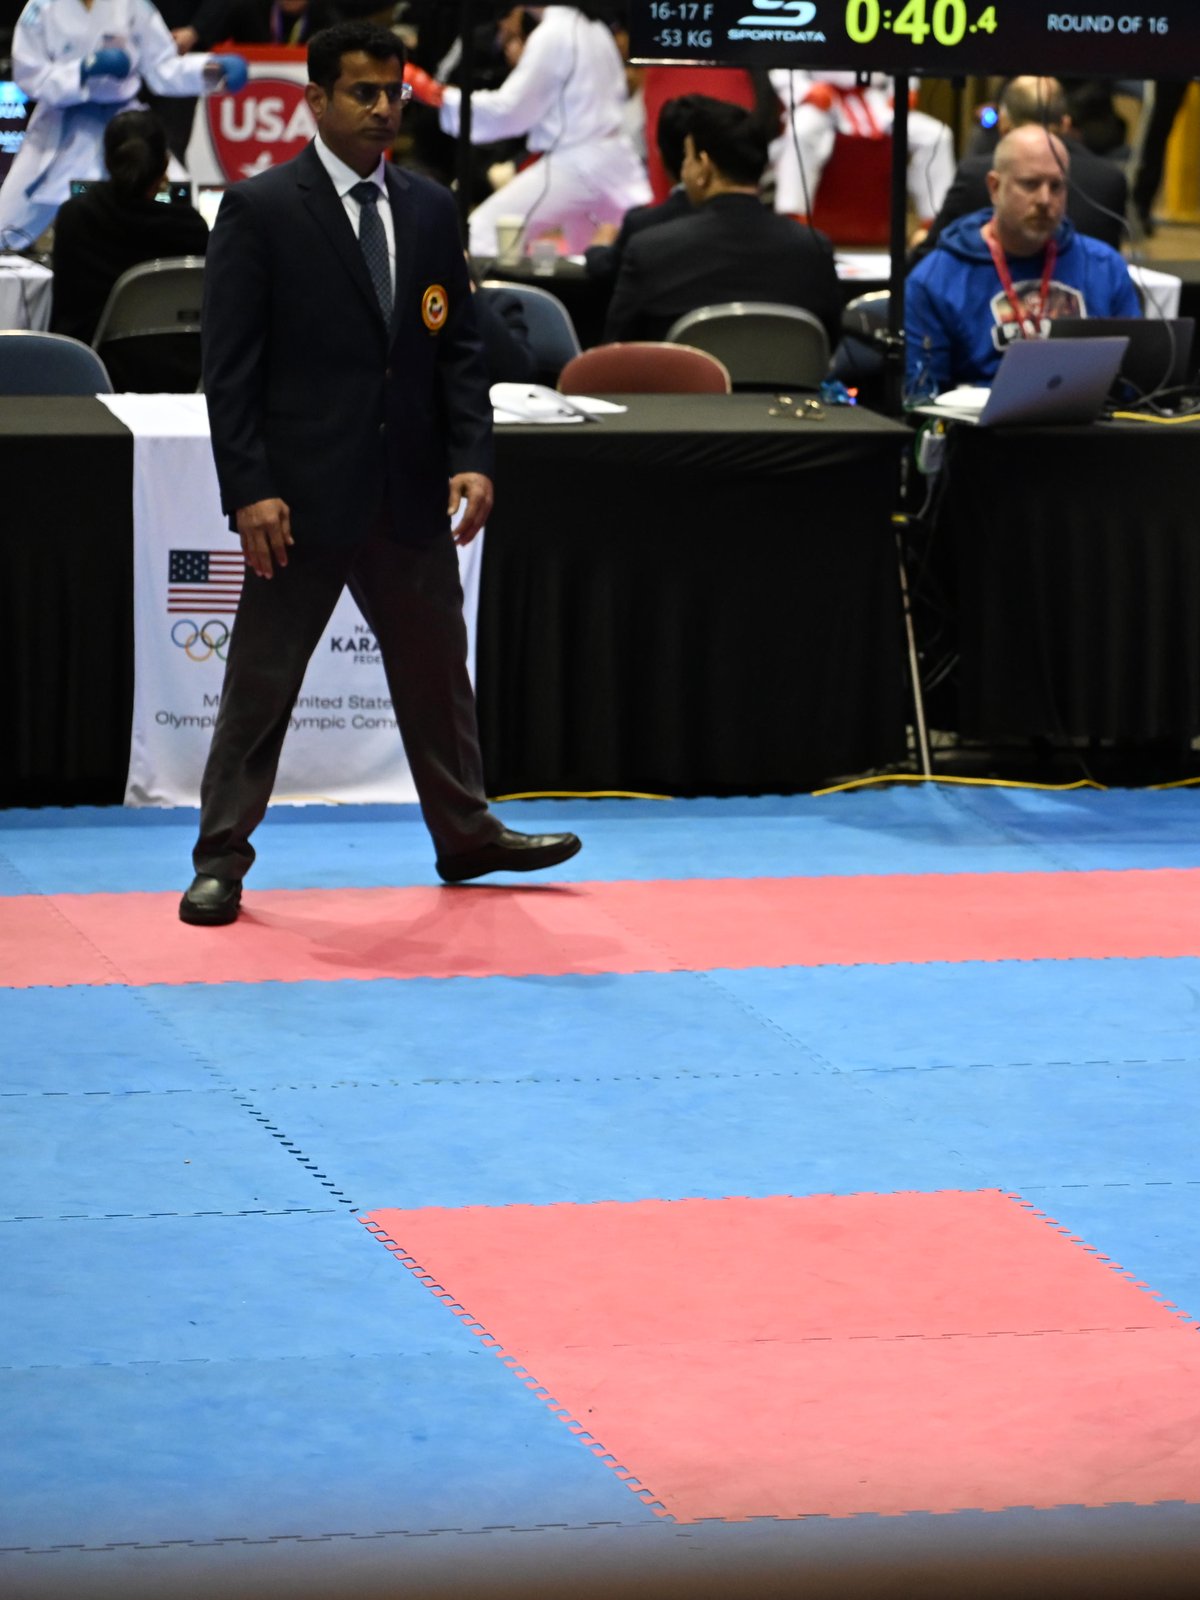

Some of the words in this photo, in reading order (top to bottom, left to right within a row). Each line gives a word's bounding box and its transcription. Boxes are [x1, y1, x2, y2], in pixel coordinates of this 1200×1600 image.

[650, 3, 699, 20] 16-17
[703, 4, 714, 20] F
[1047, 14, 1115, 33] ROUND
[1117, 15, 1143, 33] OF
[1148, 17, 1169, 35] 16
[653, 29, 683, 47] -53
[687, 30, 713, 47] KG
[727, 28, 827, 43] SPORTDATA
[220, 97, 318, 142] USA
[297, 694, 343, 709] nited
[348, 694, 392, 709] State
[155, 711, 217, 730] Olympi
